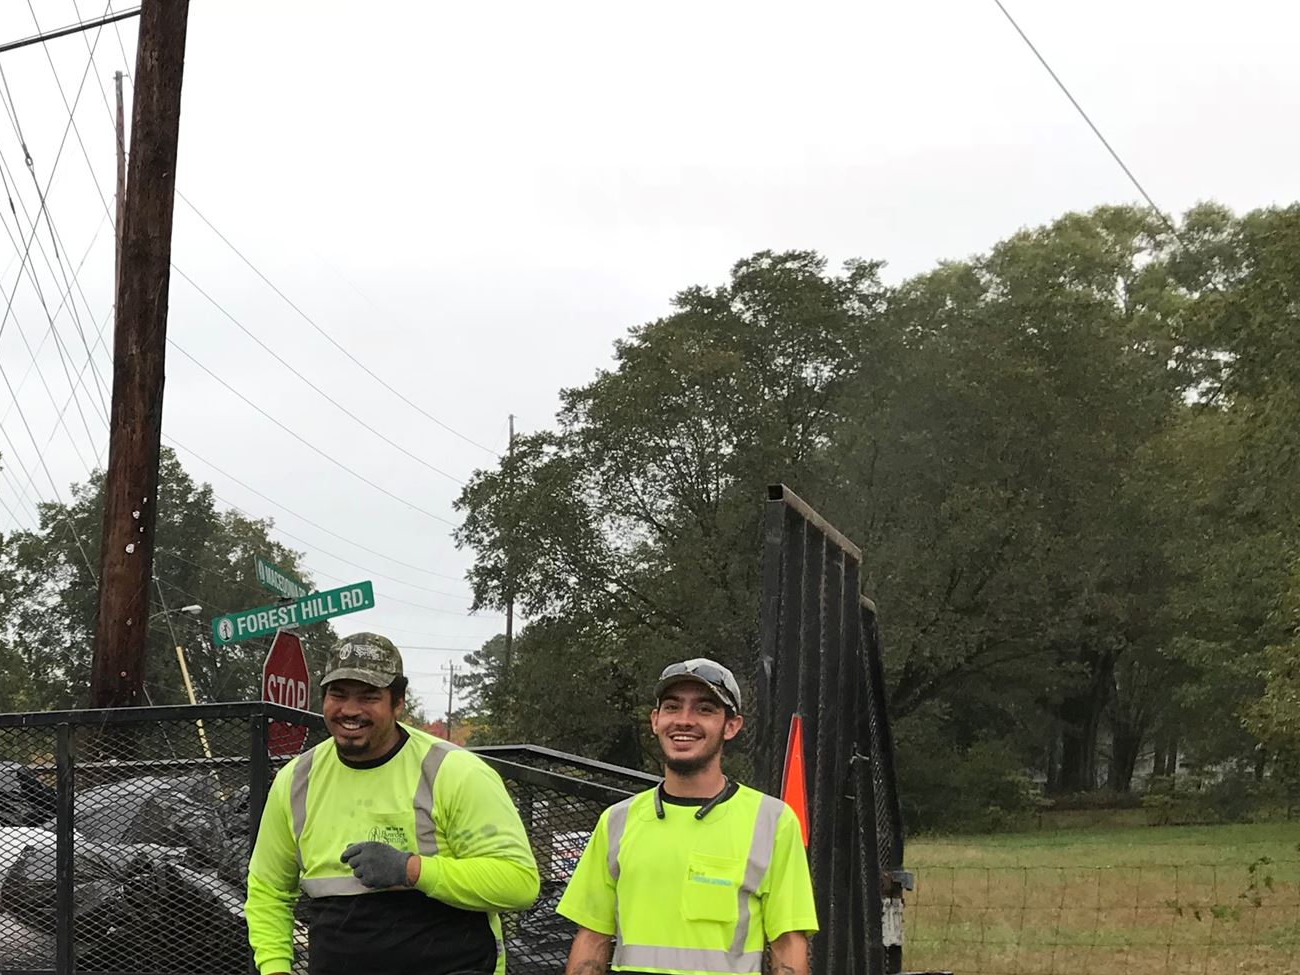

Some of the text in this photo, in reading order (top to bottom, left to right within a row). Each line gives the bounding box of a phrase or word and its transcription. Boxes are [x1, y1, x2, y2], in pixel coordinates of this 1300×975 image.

[236, 588, 370, 636] FOREST HILL RD.
[267, 673, 307, 711] STOP
